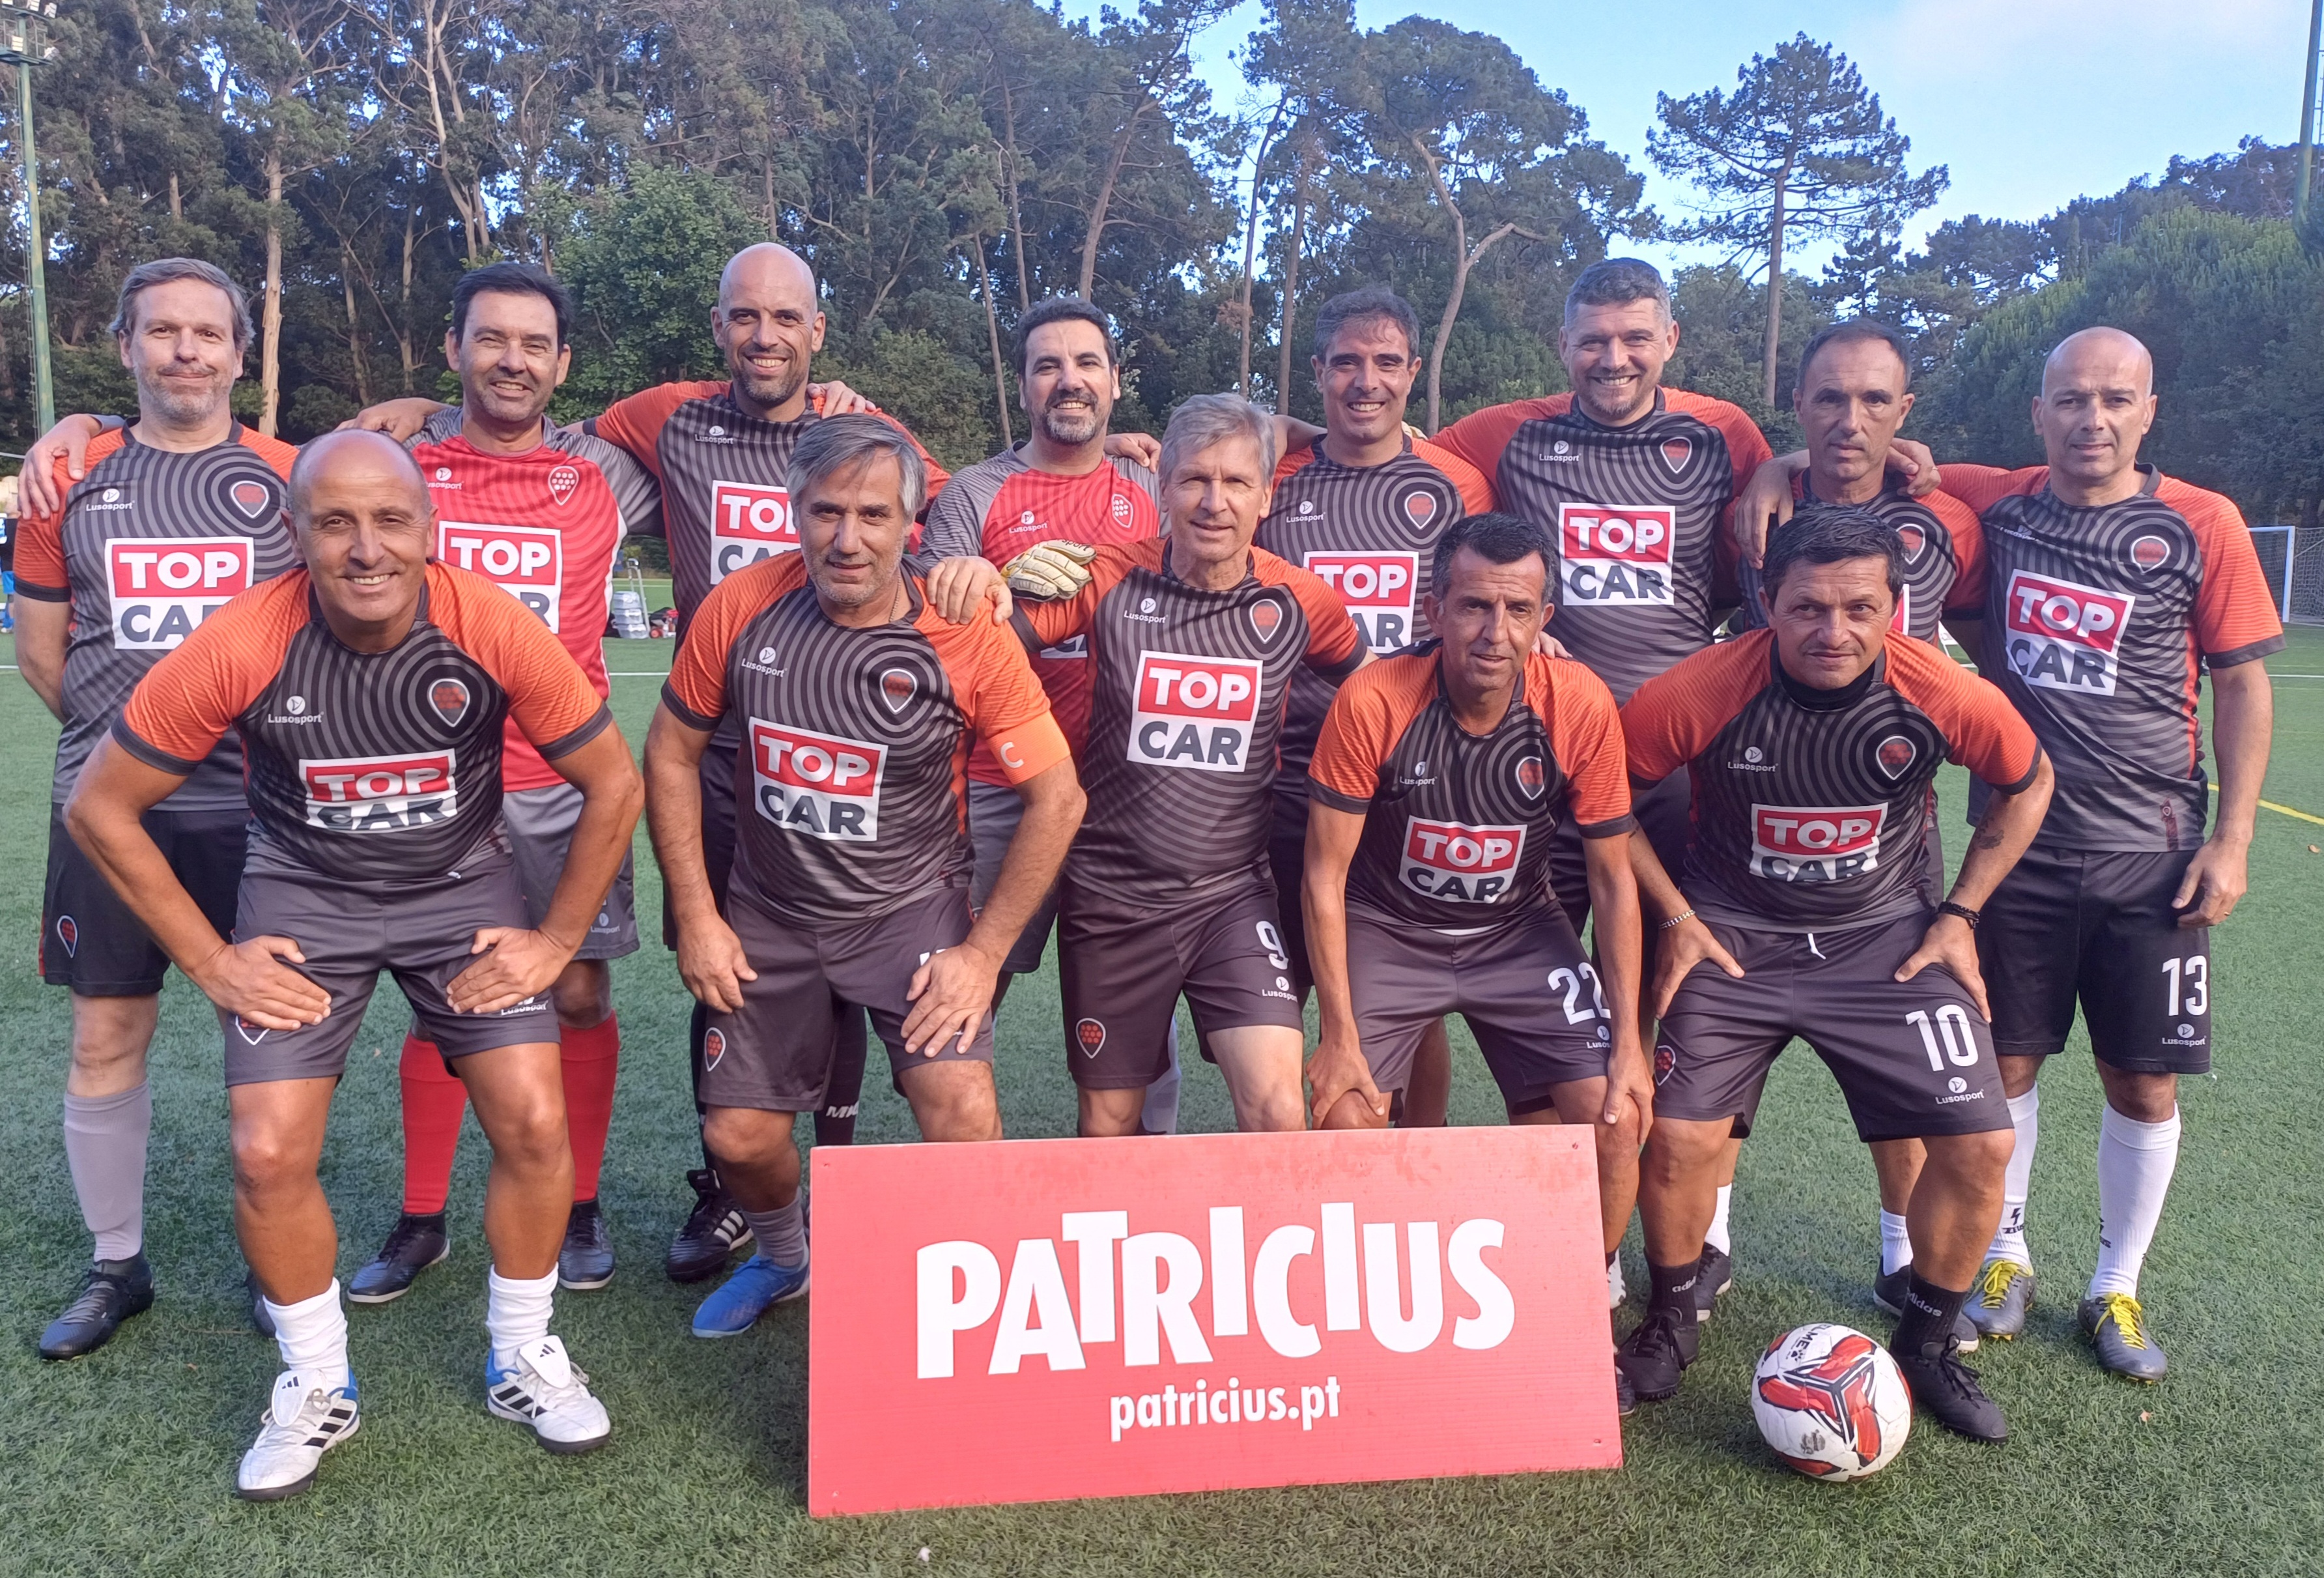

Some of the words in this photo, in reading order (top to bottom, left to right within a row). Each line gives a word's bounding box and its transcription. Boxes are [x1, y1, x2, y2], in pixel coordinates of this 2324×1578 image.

[695, 434, 733, 444] Lusosport
[1539, 453, 1580, 463] Lusosport
[427, 481, 462, 490] usosport
[86, 502, 132, 511] Lusosport
[1286, 514, 1324, 523] Lusosport
[1009, 522, 1047, 533] Lusosport
[1570, 517, 1664, 553] TOP
[119, 551, 240, 589] TOP
[451, 537, 551, 577] TOP
[1314, 564, 1408, 599] TOP
[1570, 566, 1666, 599] CAR
[120, 605, 224, 642] CA
[1124, 610, 1166, 624] Lusosport
[2017, 586, 2116, 637] TOP
[1352, 613, 1404, 647] AR
[741, 658, 784, 677] Lusosport
[2009, 639, 2106, 689] CAR
[1148, 667, 1250, 711] TOP
[268, 713, 322, 725] Lusosport
[1000, 741, 1023, 767] C
[1139, 721, 1241, 765] CAR
[759, 735, 870, 786] TOP
[1727, 762, 1776, 773] Lusosport
[314, 768, 441, 800] TOP
[317, 799, 444, 829] CAR
[760, 784, 867, 836] CAR
[1417, 831, 1513, 867] TOP
[1764, 818, 1872, 849] TOP
[1407, 867, 1505, 902] CAR
[1761, 853, 1868, 882] CAR
[1256, 921, 1288, 969] 9
[1548, 962, 1611, 1026] 22
[2162, 955, 2207, 1016] 13
[1905, 1005, 1979, 1071] 10
[2162, 1037, 2205, 1047] Lusosport
[1935, 1090, 1984, 1104] Lusosport
[917, 1202, 1514, 1379] PATRICIUS
[1908, 1293, 1942, 1317] didas
[1111, 1377, 1340, 1441] patricius.pt
